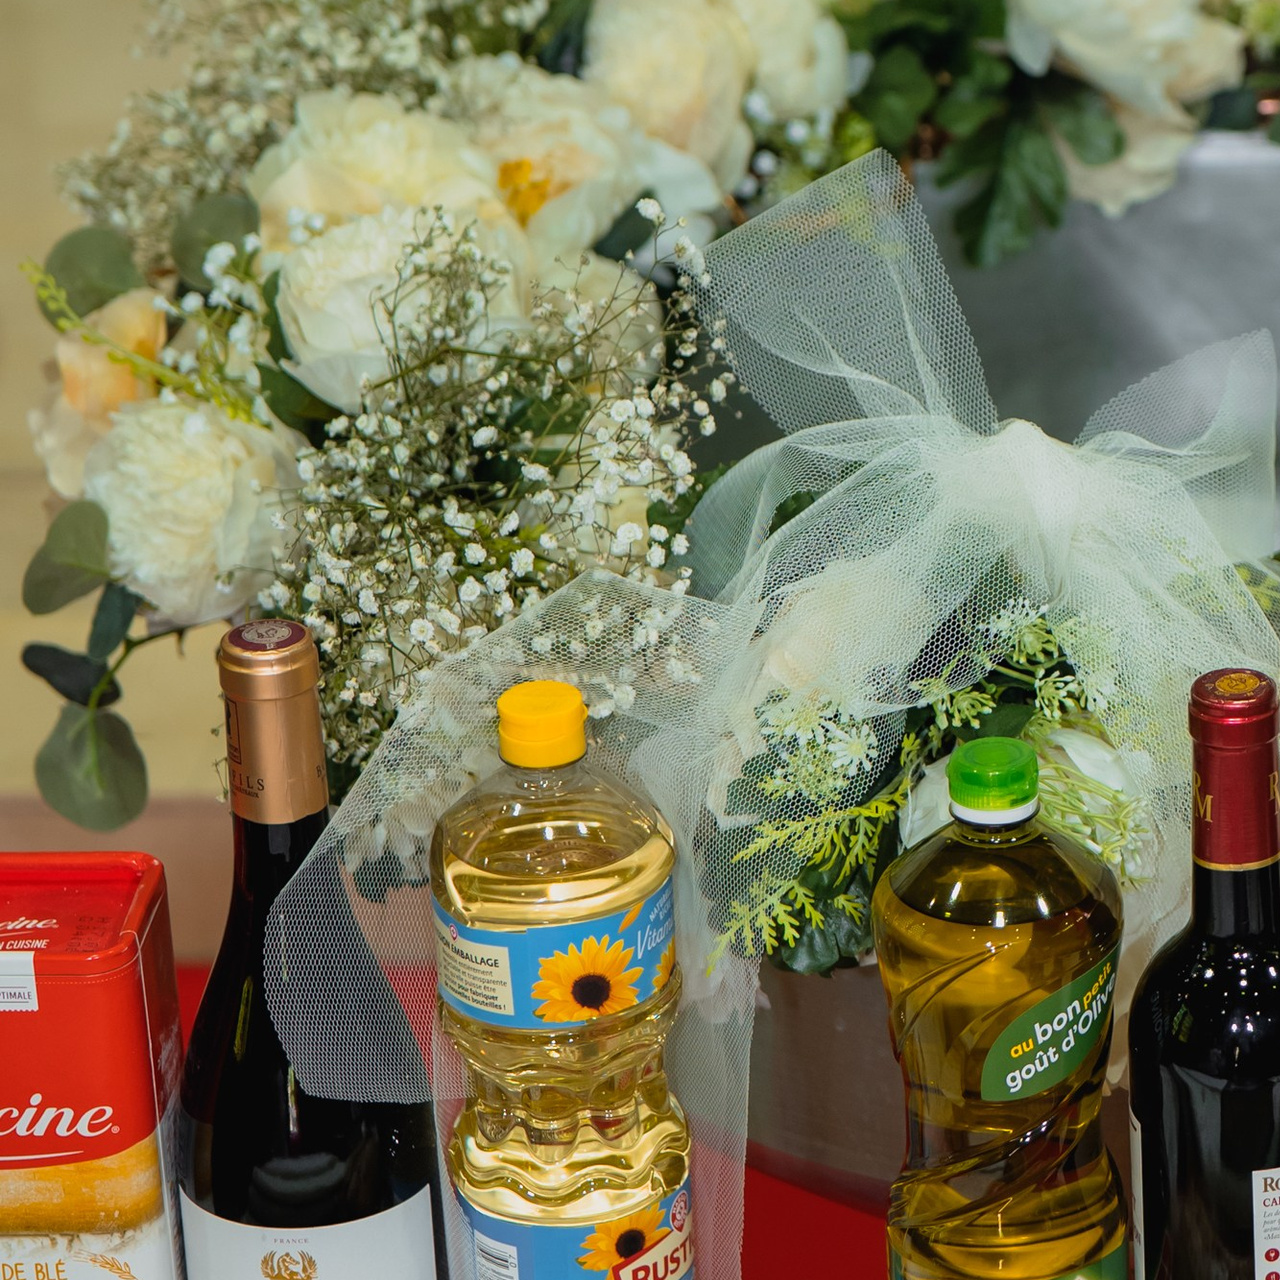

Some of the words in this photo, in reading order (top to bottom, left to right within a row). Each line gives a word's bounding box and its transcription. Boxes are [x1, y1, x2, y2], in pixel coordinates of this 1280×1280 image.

[6, 939, 50, 950] CUISINE
[451, 943, 500, 968] EMBALLAGE
[1009, 1037, 1034, 1058] au
[1034, 999, 1081, 1045] bon
[1083, 962, 1112, 1010] petit
[1005, 1046, 1060, 1093] goût
